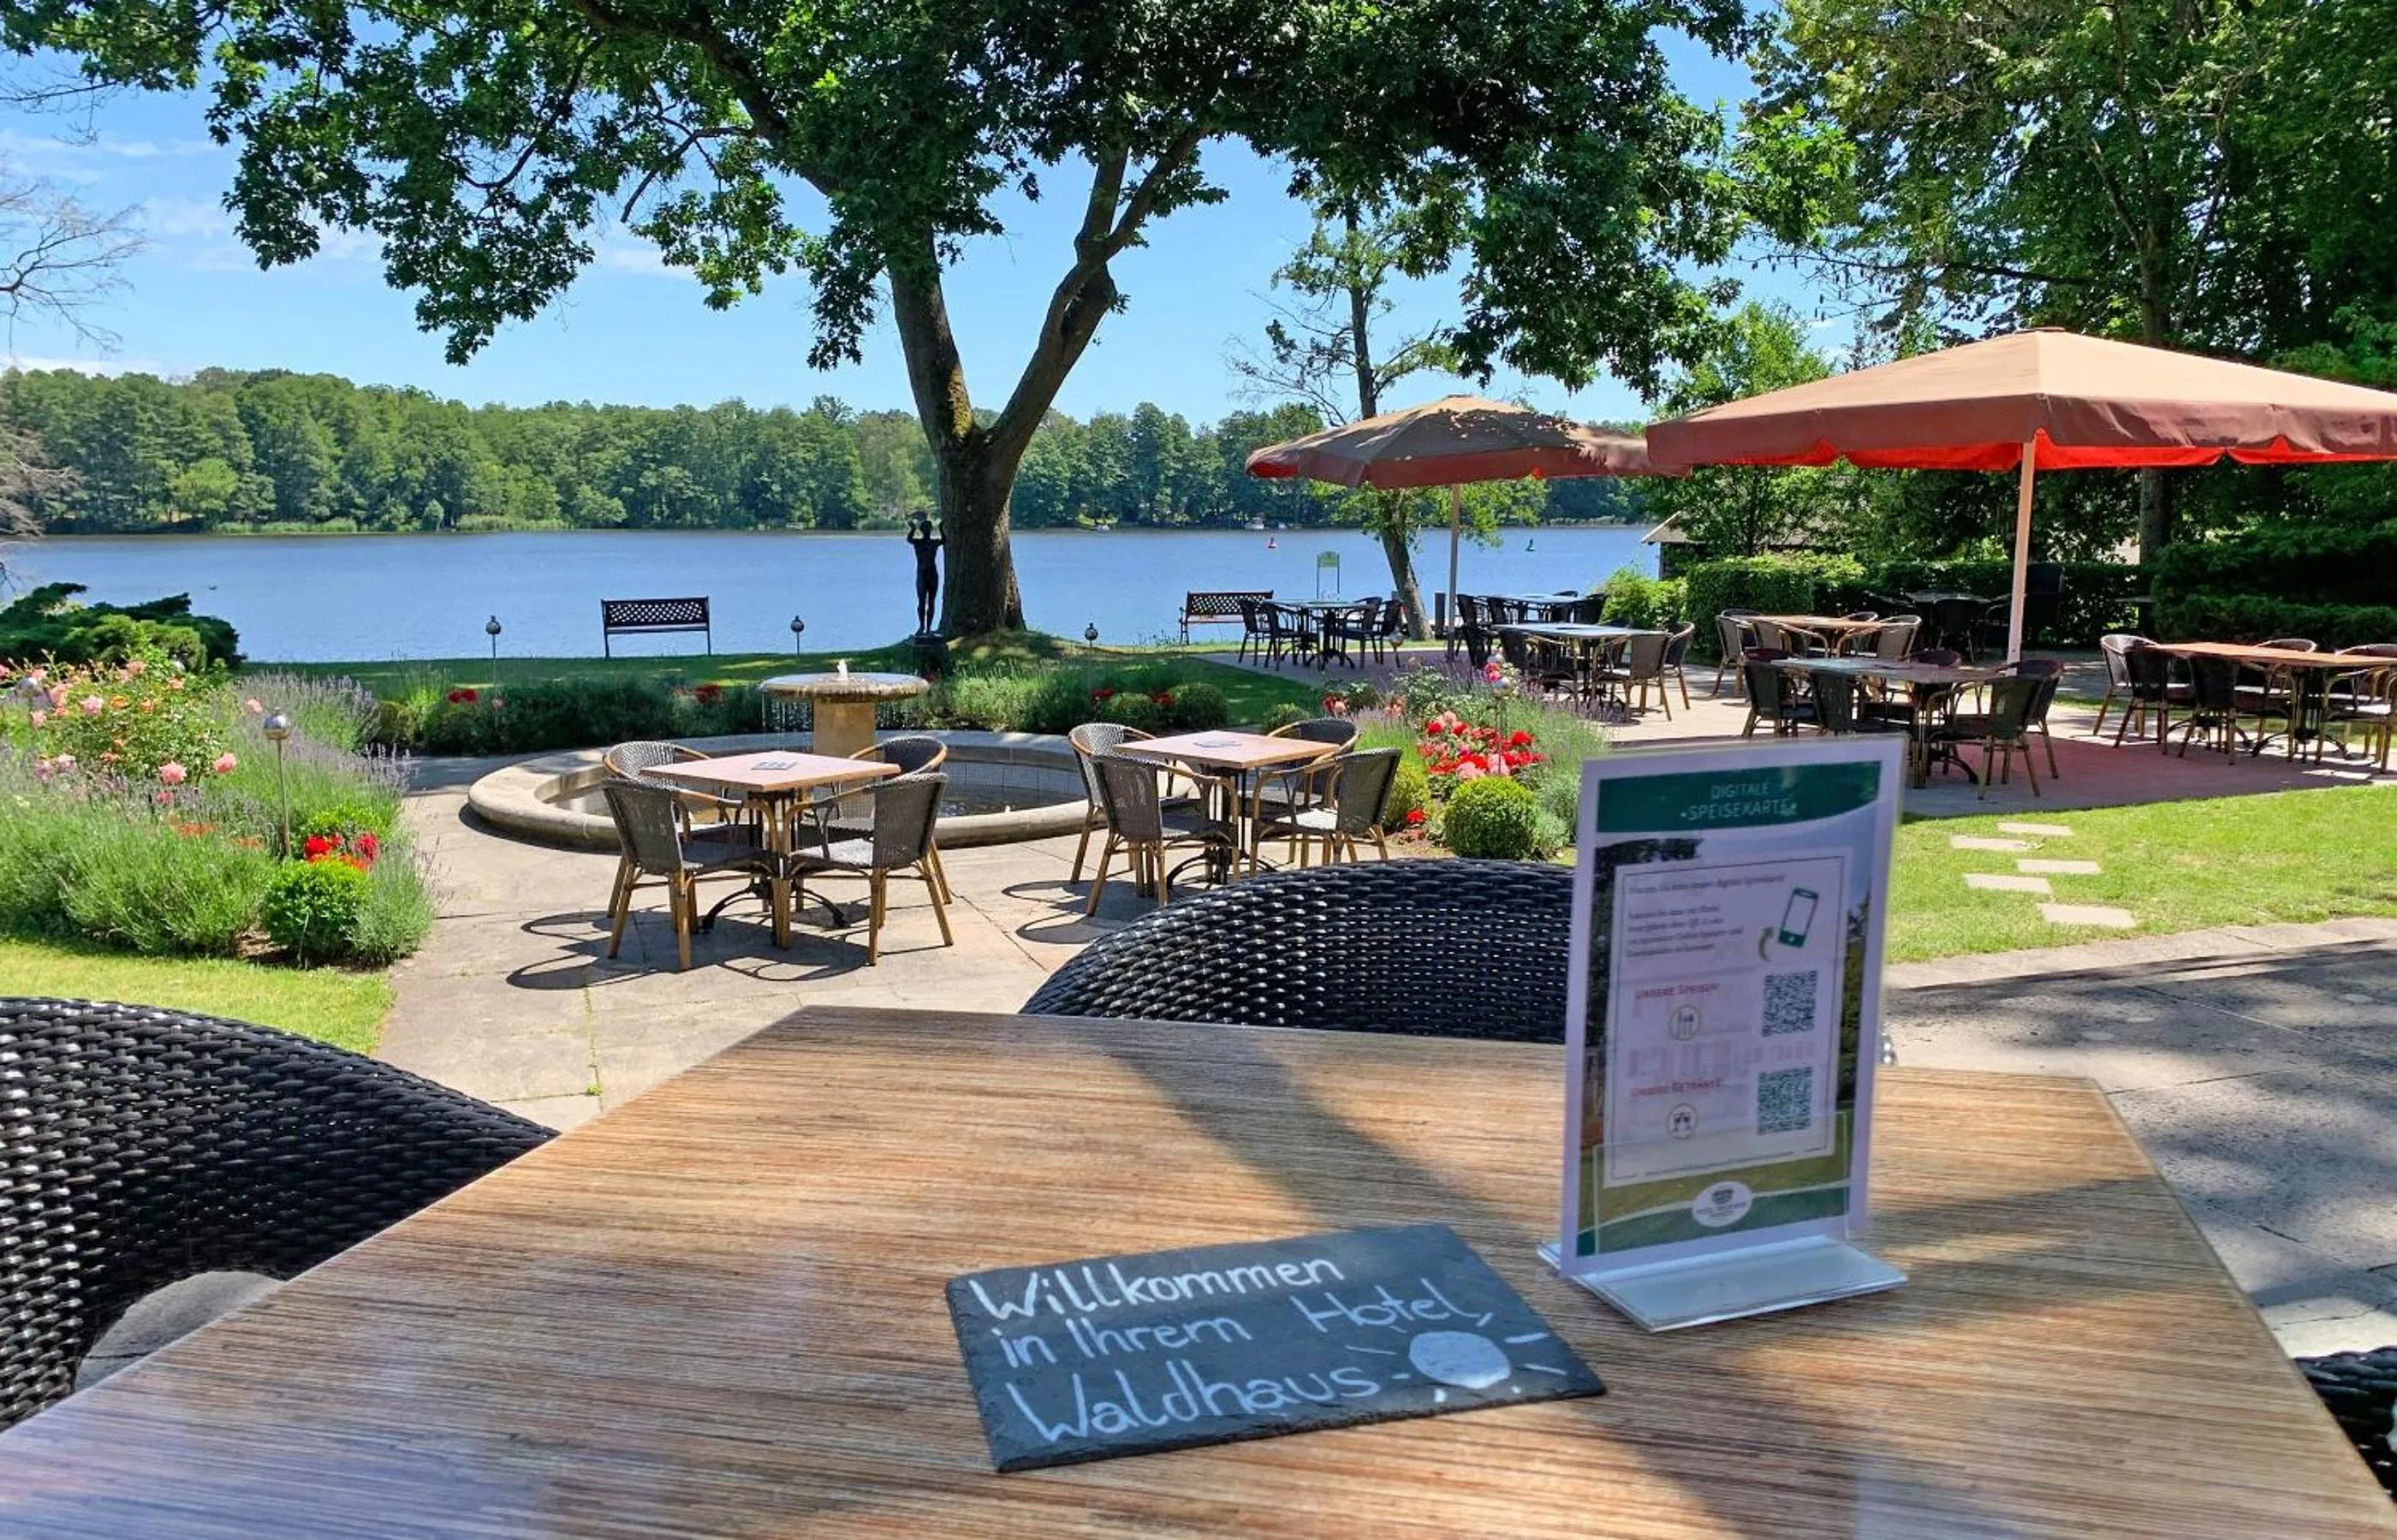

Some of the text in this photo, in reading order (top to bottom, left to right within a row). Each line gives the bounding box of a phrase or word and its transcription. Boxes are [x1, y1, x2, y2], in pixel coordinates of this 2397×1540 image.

[969, 1256, 1344, 1320] Willkommen
[990, 1328, 1056, 1368] in
[1065, 1317, 1253, 1359] Ihrem
[1006, 1360, 1381, 1442] Waldhaus
